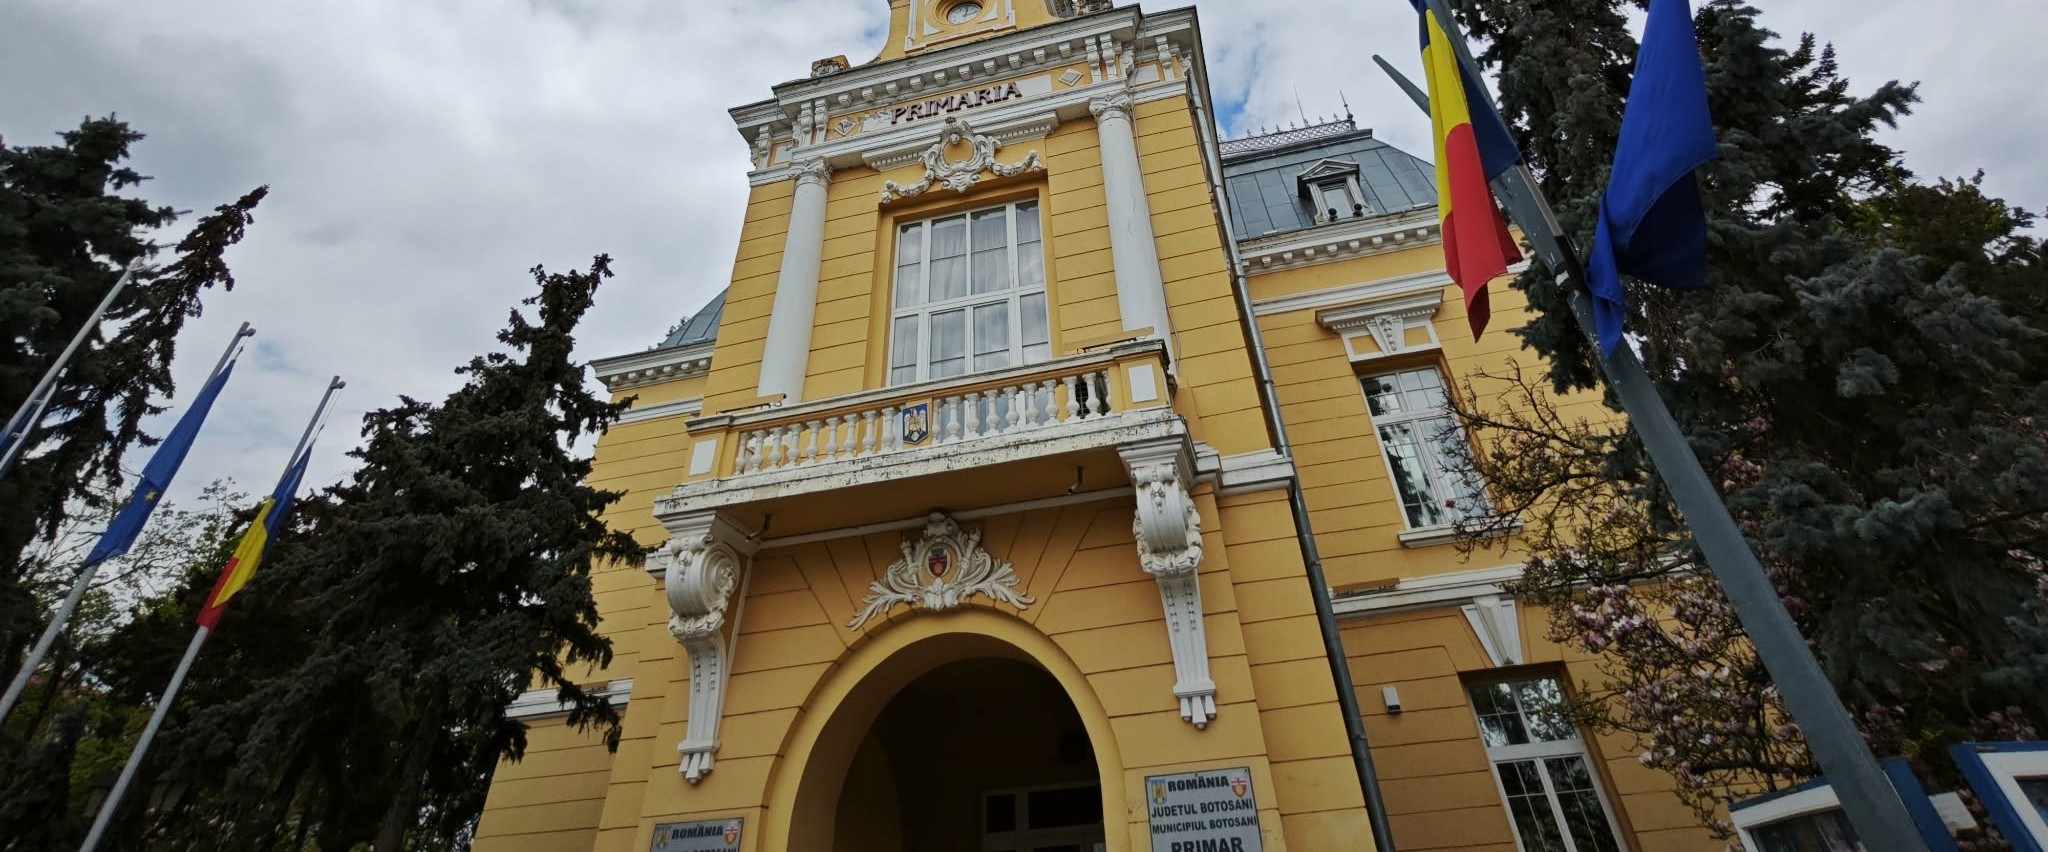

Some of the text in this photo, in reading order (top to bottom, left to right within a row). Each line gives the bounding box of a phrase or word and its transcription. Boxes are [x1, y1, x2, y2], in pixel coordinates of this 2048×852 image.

[891, 81, 1023, 125] PRIMARIA
[1168, 775, 1230, 792] ROMÂNIA
[1152, 798, 1253, 818] JUDETUL BOTOSANI
[671, 824, 724, 840] ROMÂNIA
[1152, 815, 1257, 834] MUNICIPIUL BOTOSANI
[1171, 837, 1244, 852] PRIMAR
